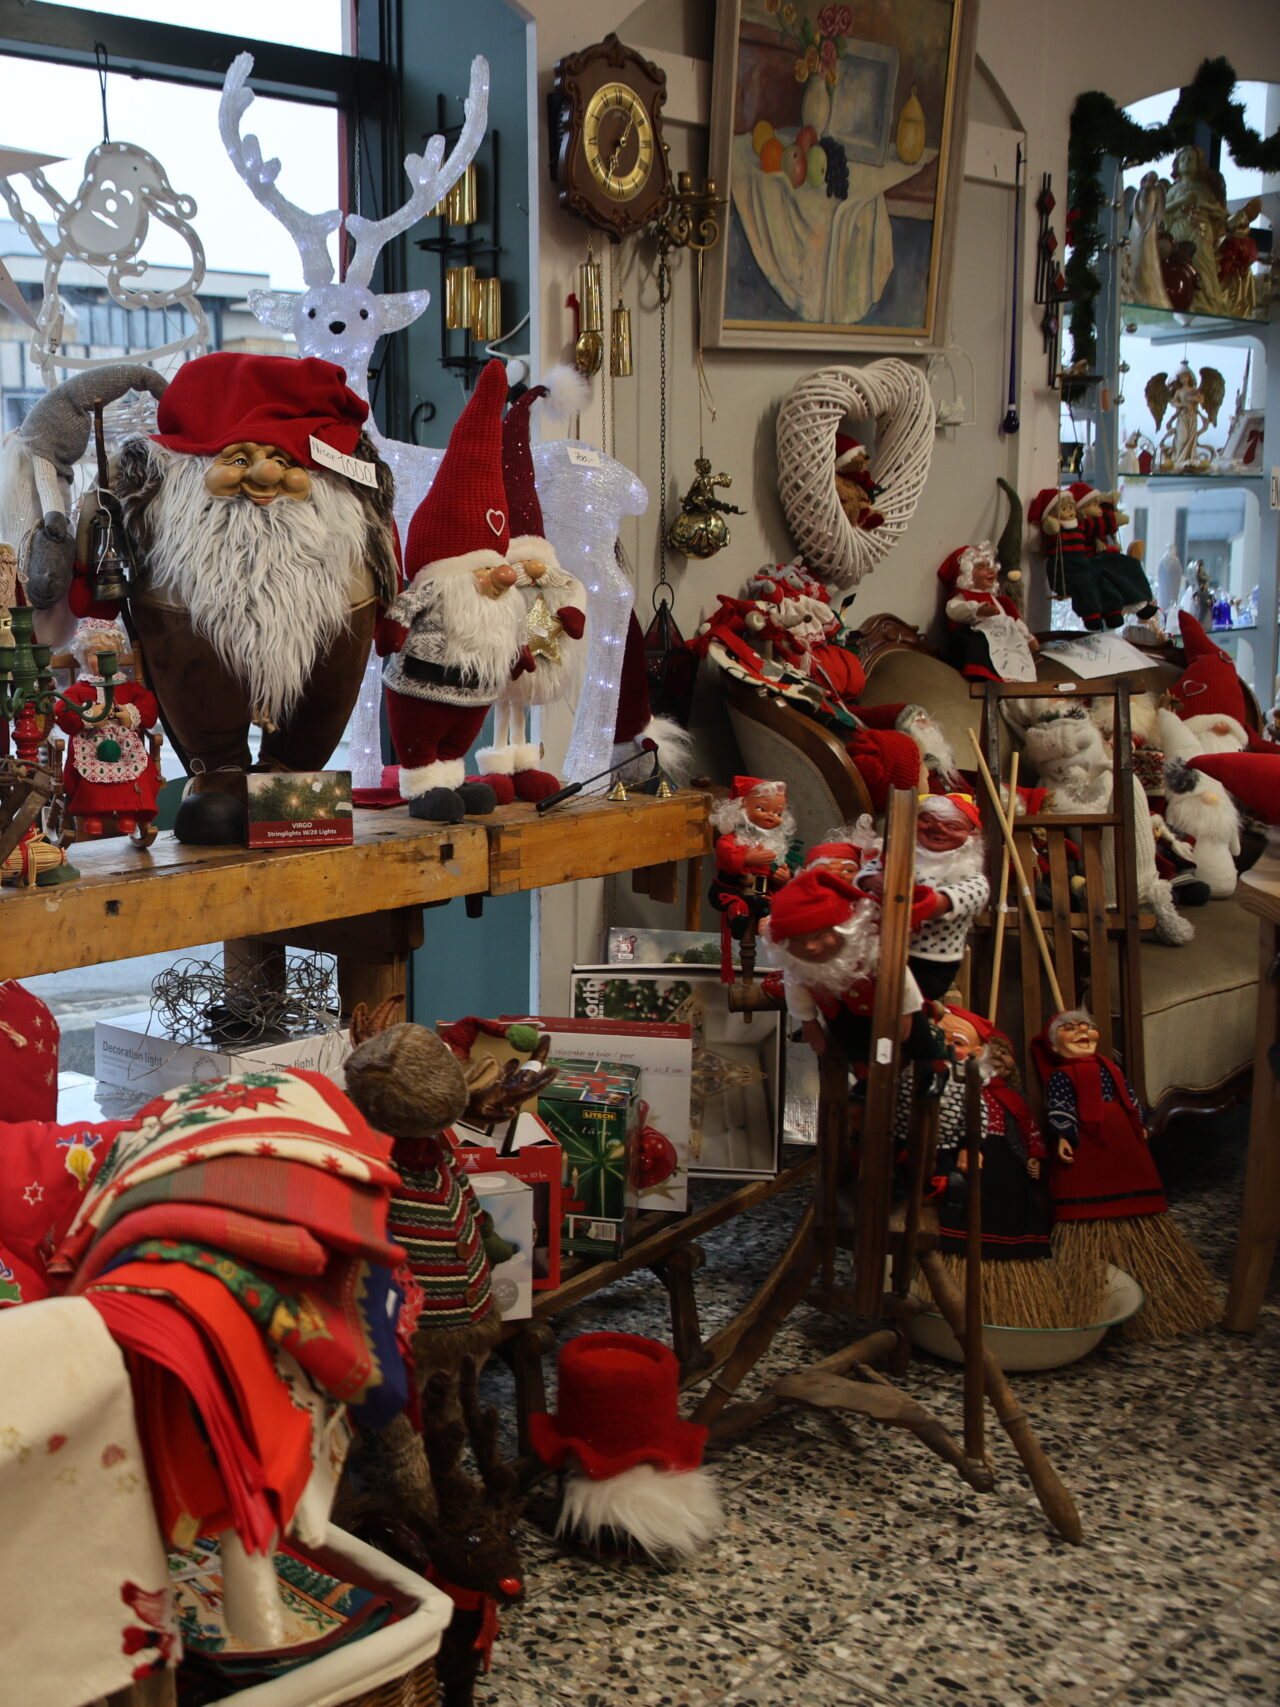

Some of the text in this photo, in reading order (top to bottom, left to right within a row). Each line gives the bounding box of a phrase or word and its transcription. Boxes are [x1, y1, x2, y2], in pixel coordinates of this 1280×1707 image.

[267, 830, 302, 838] Stringlights
[318, 828, 337, 836] Lights
[102, 1040, 162, 1067] Decoration light
